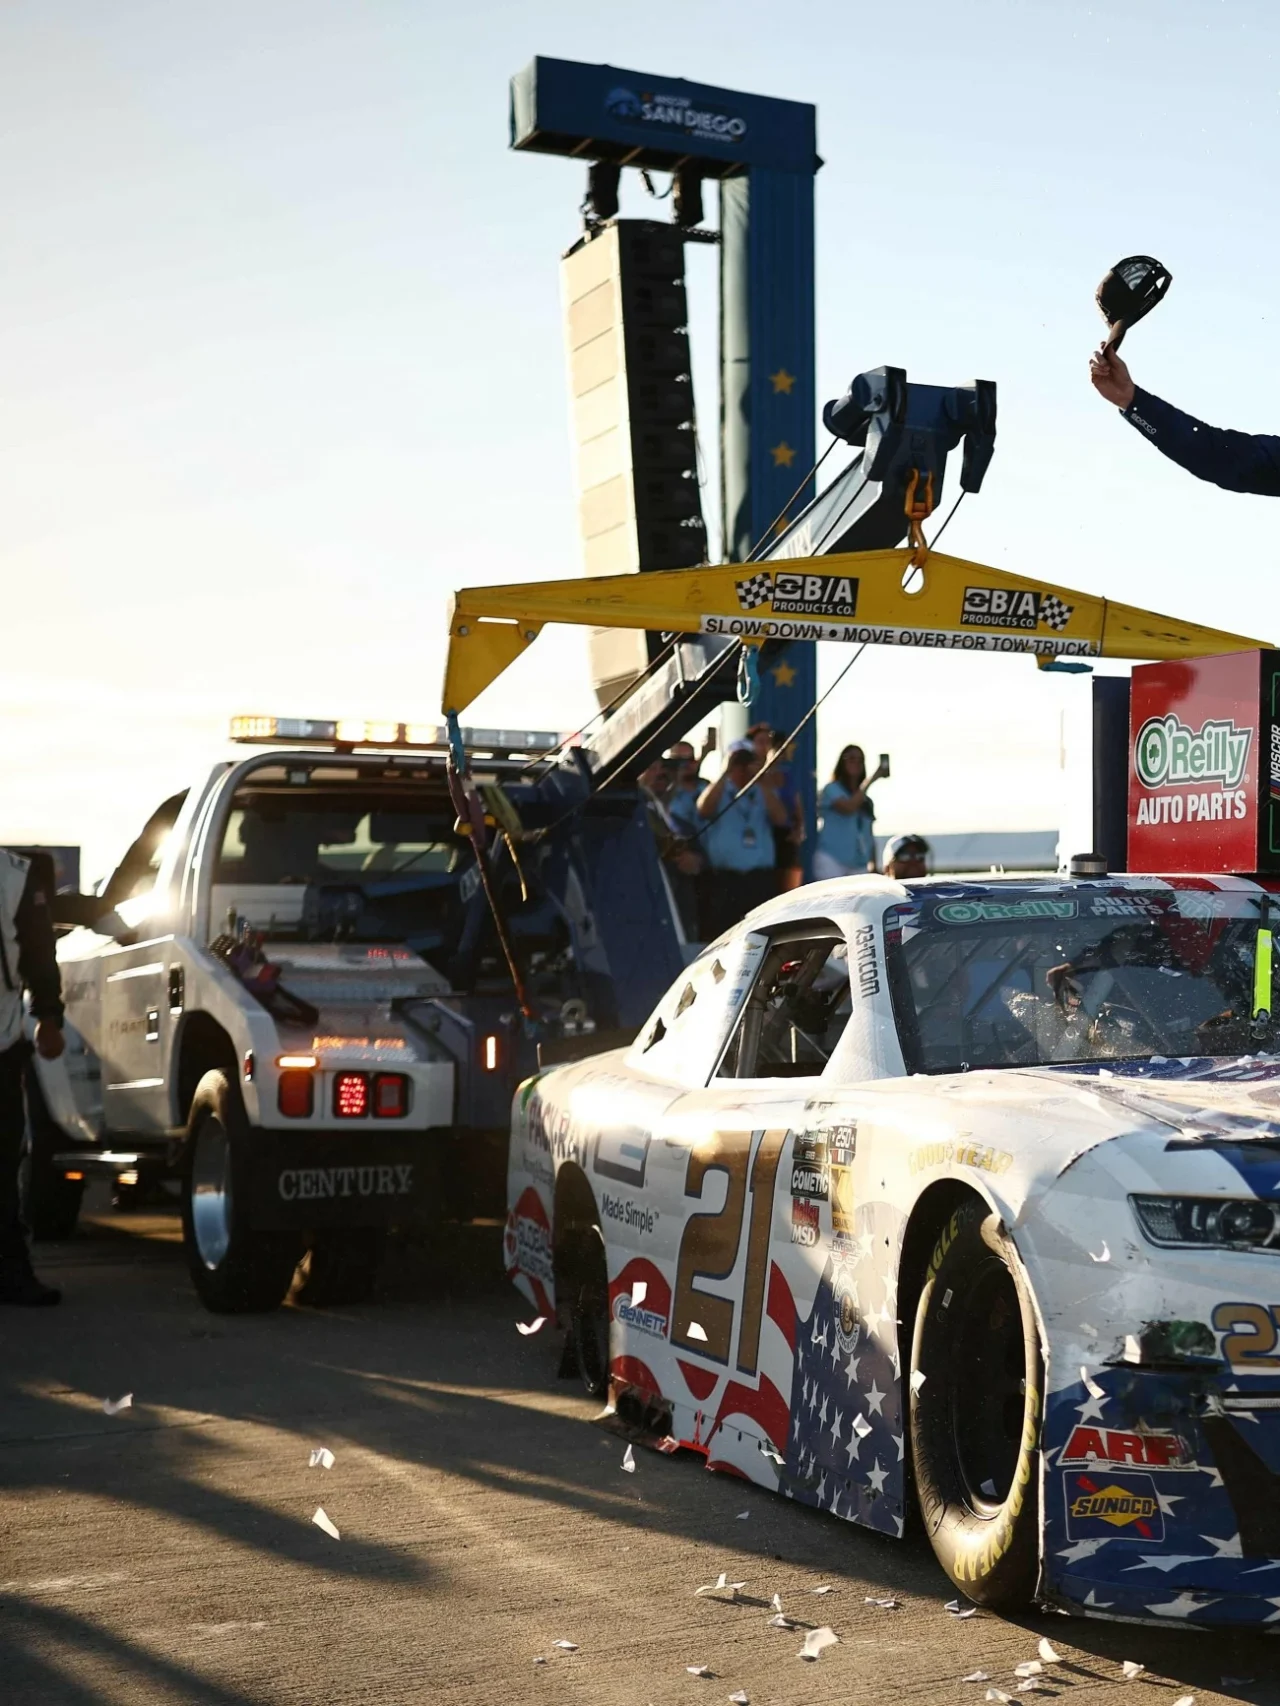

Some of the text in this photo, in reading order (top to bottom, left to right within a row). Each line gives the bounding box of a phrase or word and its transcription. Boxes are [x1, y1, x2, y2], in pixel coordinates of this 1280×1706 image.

[641, 103, 683, 124] SAN
[684, 110, 747, 136] DIEGO
[803, 576, 853, 604] B/A
[990, 590, 1036, 616] B/A
[773, 601, 834, 615] PRODUCTS
[962, 614, 1018, 627] PRODUCTS
[705, 618, 1100, 657] SLOW DOWN MOVE OVER FOR TOW TRUCKS
[1138, 719, 1248, 783] O'Reilly
[1136, 790, 1247, 826] AUTO PARTS
[1091, 904, 1165, 917] PARTS
[1093, 896, 1150, 907] AUTO
[835, 1127, 851, 1149] 250
[278, 1165, 413, 1200] CENTURY
[792, 1170, 828, 1194] COMETIC
[602, 1193, 653, 1235] Made Simple
[791, 1224, 817, 1246] MSD
[671, 1127, 791, 1380] 21
[619, 1305, 665, 1332] BENNETT
[1074, 1497, 1154, 1516] SUNOCO
